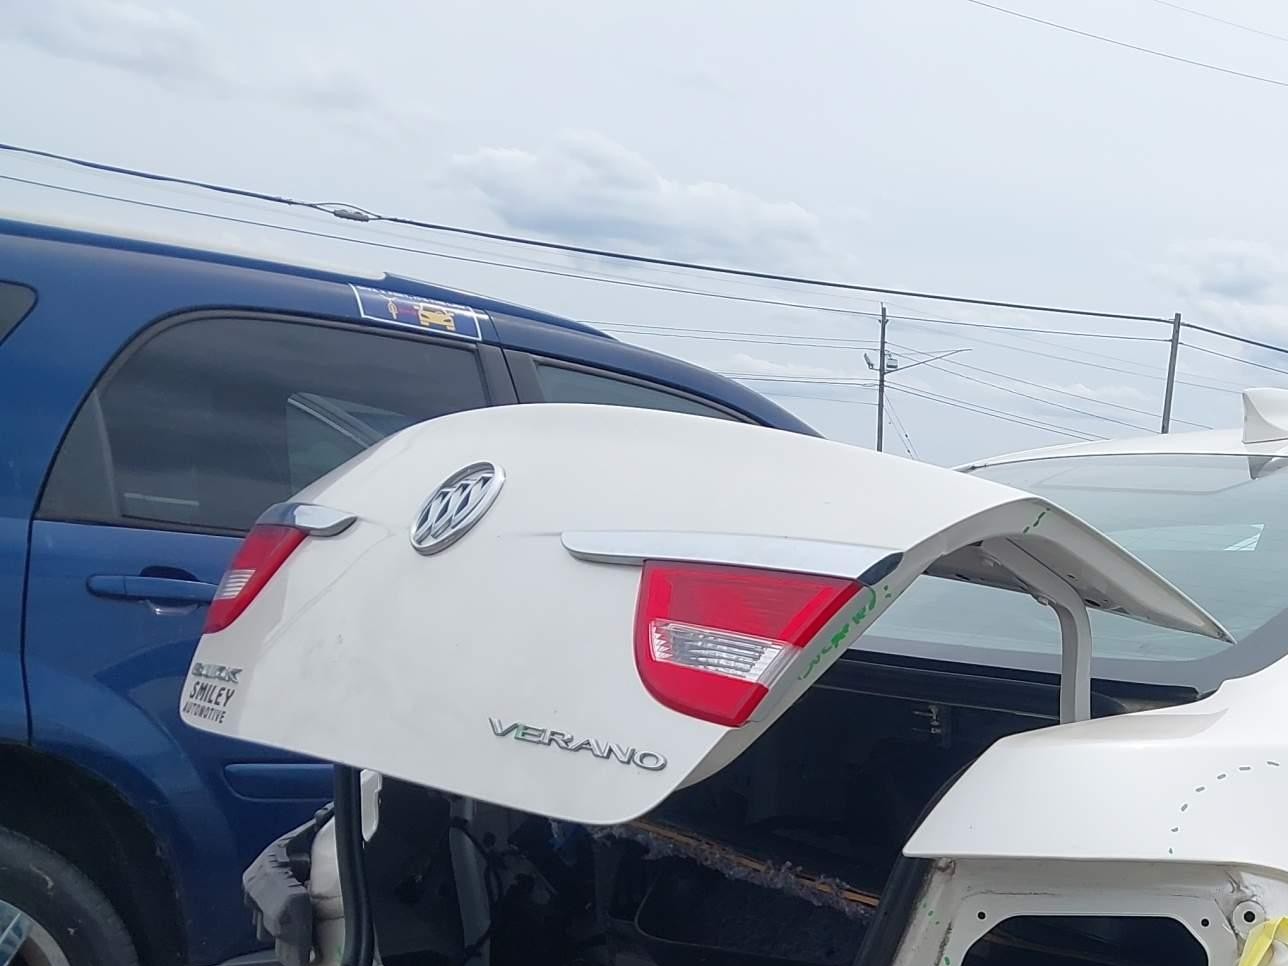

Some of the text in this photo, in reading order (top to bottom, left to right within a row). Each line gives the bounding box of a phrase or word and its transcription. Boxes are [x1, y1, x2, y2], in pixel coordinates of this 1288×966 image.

[189, 680, 236, 708] SMILEY
[182, 701, 227, 724] AUTOMOTIVE
[488, 716, 667, 771] VERANO
